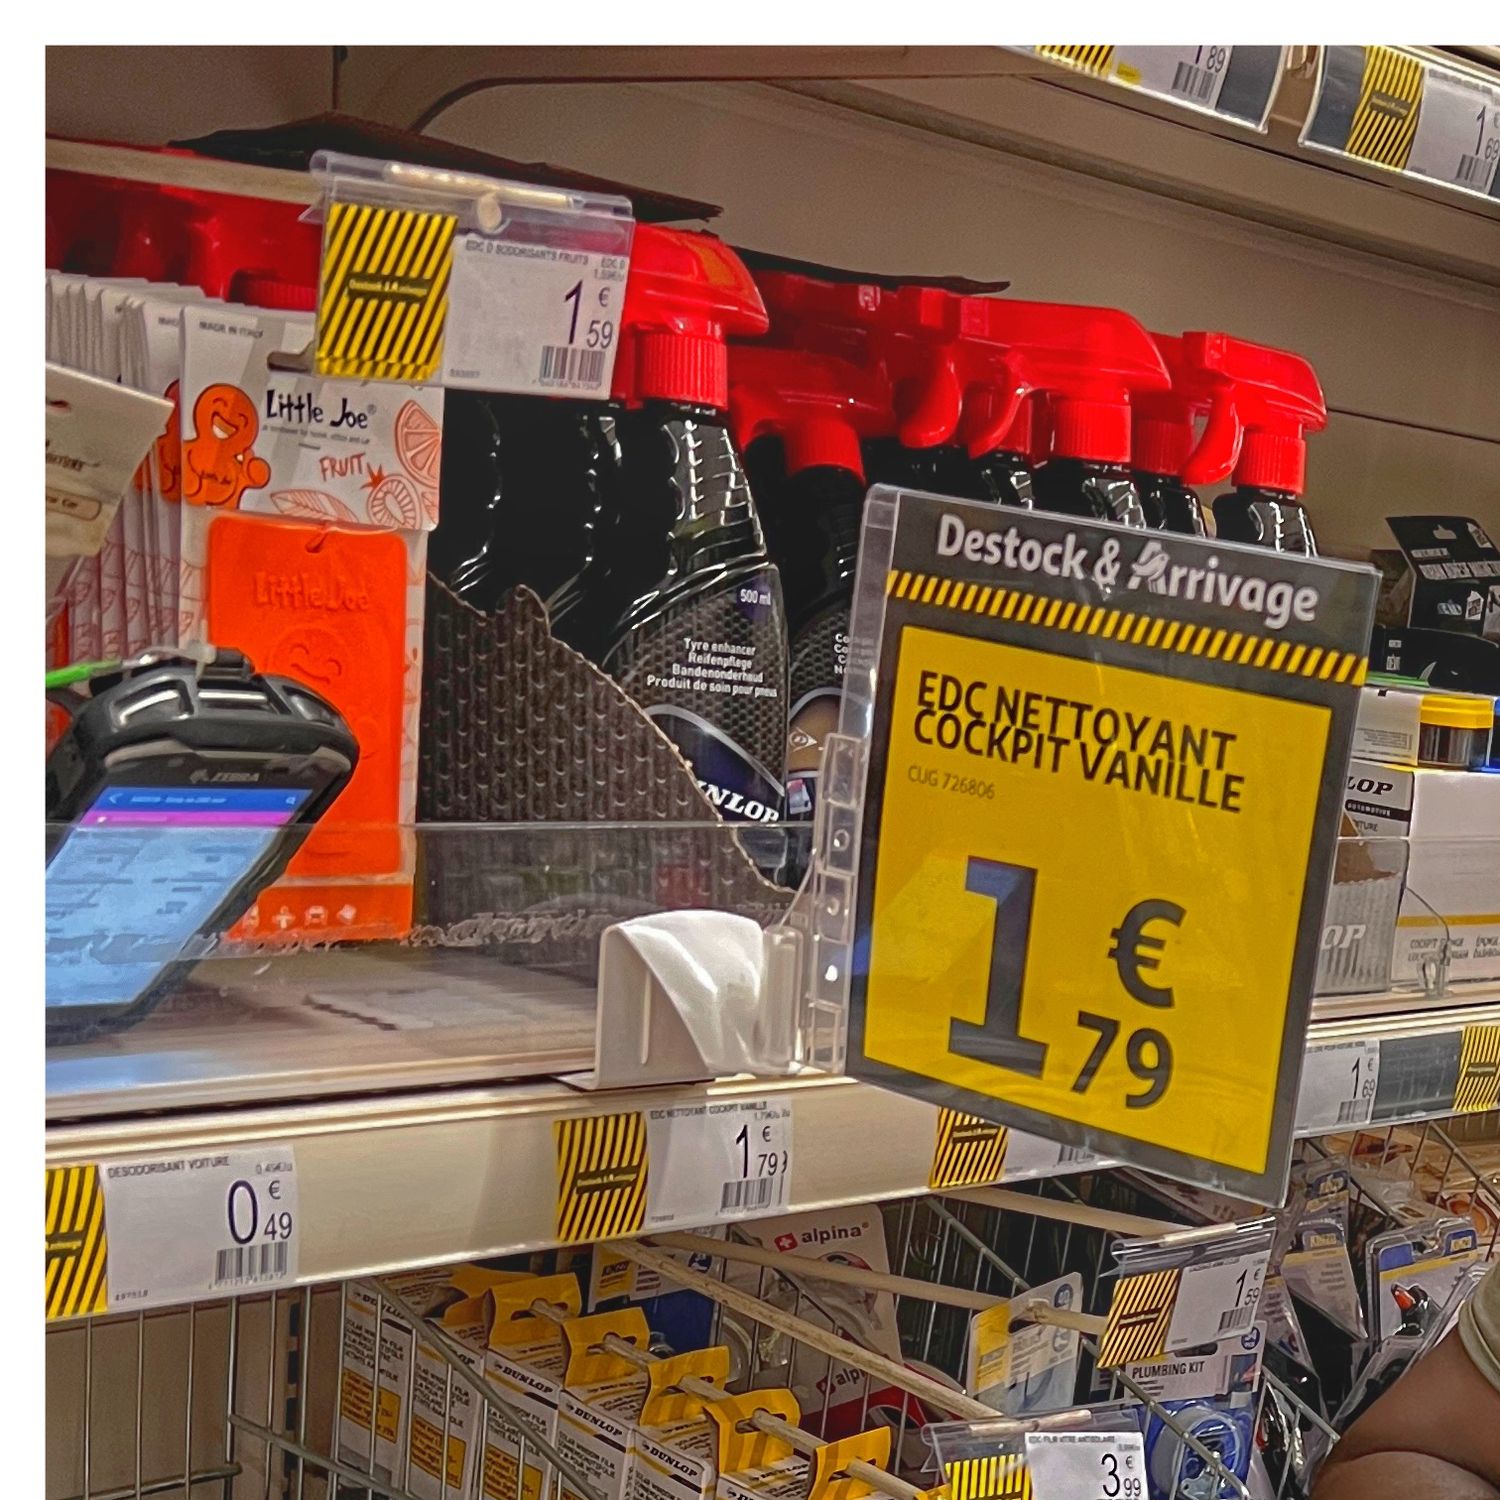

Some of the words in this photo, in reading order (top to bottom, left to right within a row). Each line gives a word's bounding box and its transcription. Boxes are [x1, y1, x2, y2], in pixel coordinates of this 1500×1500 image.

[563, 279, 584, 346] 1
[598, 286, 611, 308] €
[586, 319, 615, 350] 59
[265, 388, 324, 425] Little
[329, 397, 370, 430] Joe
[318, 451, 367, 482] FRUIT
[936, 513, 1088, 580] Destock
[1092, 537, 1121, 587] &
[1127, 540, 1320, 630] Arrivage
[740, 589, 759, 605] 500
[759, 592, 772, 606] ml
[684, 638, 710, 653] Tyre
[711, 640, 757, 656] enhancer
[688, 652, 754, 671] Reifenpflege
[647, 674, 692, 691] Produit
[693, 678, 707, 692] de
[708, 680, 732, 694] soin
[731, 683, 755, 698] pour
[754, 686, 779, 699] pneus
[672, 663, 765, 684] Bandenonderhoud
[916, 669, 988, 718] EDC
[995, 685, 1238, 772] NETTOYANT
[913, 707, 1070, 774] COCKPIT
[1080, 740, 1246, 814] VANILLE
[907, 763, 939, 788] CUG
[941, 768, 996, 801] 726806
[948, 855, 1050, 1081] 1
[1106, 898, 1188, 1010] €
[1070, 1009, 1175, 1111] 79
[1351, 1056, 1361, 1100] 1
[761, 1125, 772, 1143] €
[735, 1123, 750, 1179] 1
[757, 1151, 779, 1178] 79
[107, 1159, 186, 1179] DESODORISANT
[188, 1155, 230, 1169] VOITURE
[268, 1179, 282, 1200] €
[227, 1178, 259, 1246] 0
[263, 1211, 294, 1242] 49
[800, 1224, 863, 1246] alpina
[1235, 1267, 1249, 1308] 1
[1244, 1286, 1261, 1307] 59
[502, 1365, 554, 1395] DUNLOP
[1131, 1362, 1187, 1380] PLUMBING
[1188, 1360, 1205, 1375] KIT
[574, 1407, 624, 1437] DUNLOP
[649, 1445, 698, 1478] DUNLOP
[1101, 1453, 1121, 1498] 3
[1125, 1455, 1135, 1470] €
[1123, 1477, 1143, 1498] 99
